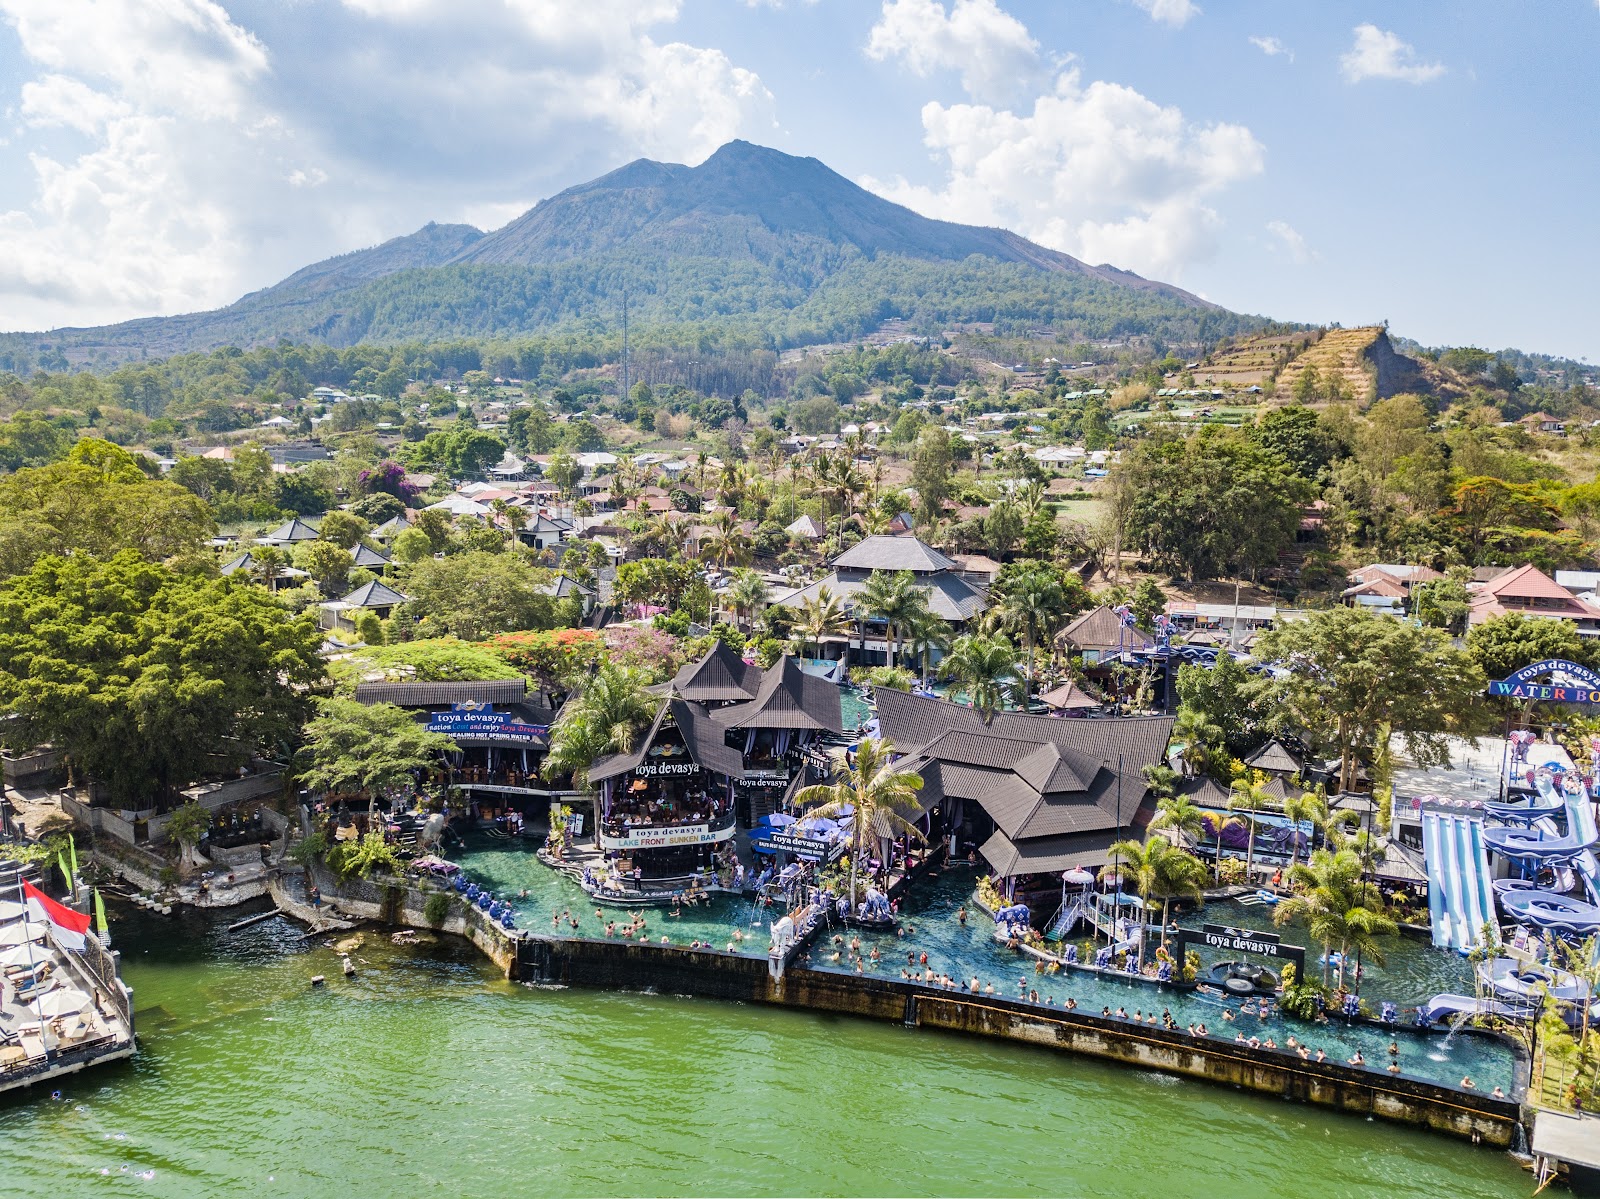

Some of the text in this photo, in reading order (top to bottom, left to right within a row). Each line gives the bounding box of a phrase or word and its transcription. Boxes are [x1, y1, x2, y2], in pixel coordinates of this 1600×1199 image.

[1517, 660, 1600, 687] toya devasya
[1497, 682, 1566, 700] WATER
[438, 712, 504, 723] toya devasya
[482, 723, 500, 732] enjoy
[510, 733, 531, 741] WATER
[635, 761, 699, 777] toya devasya
[739, 778, 788, 788] toya devasya
[636, 826, 702, 838] toya devasya
[618, 833, 716, 847] LAKE FRONT SUNKEN BAR
[773, 834, 825, 850] toya devasya
[1205, 932, 1277, 956] toya devasya
